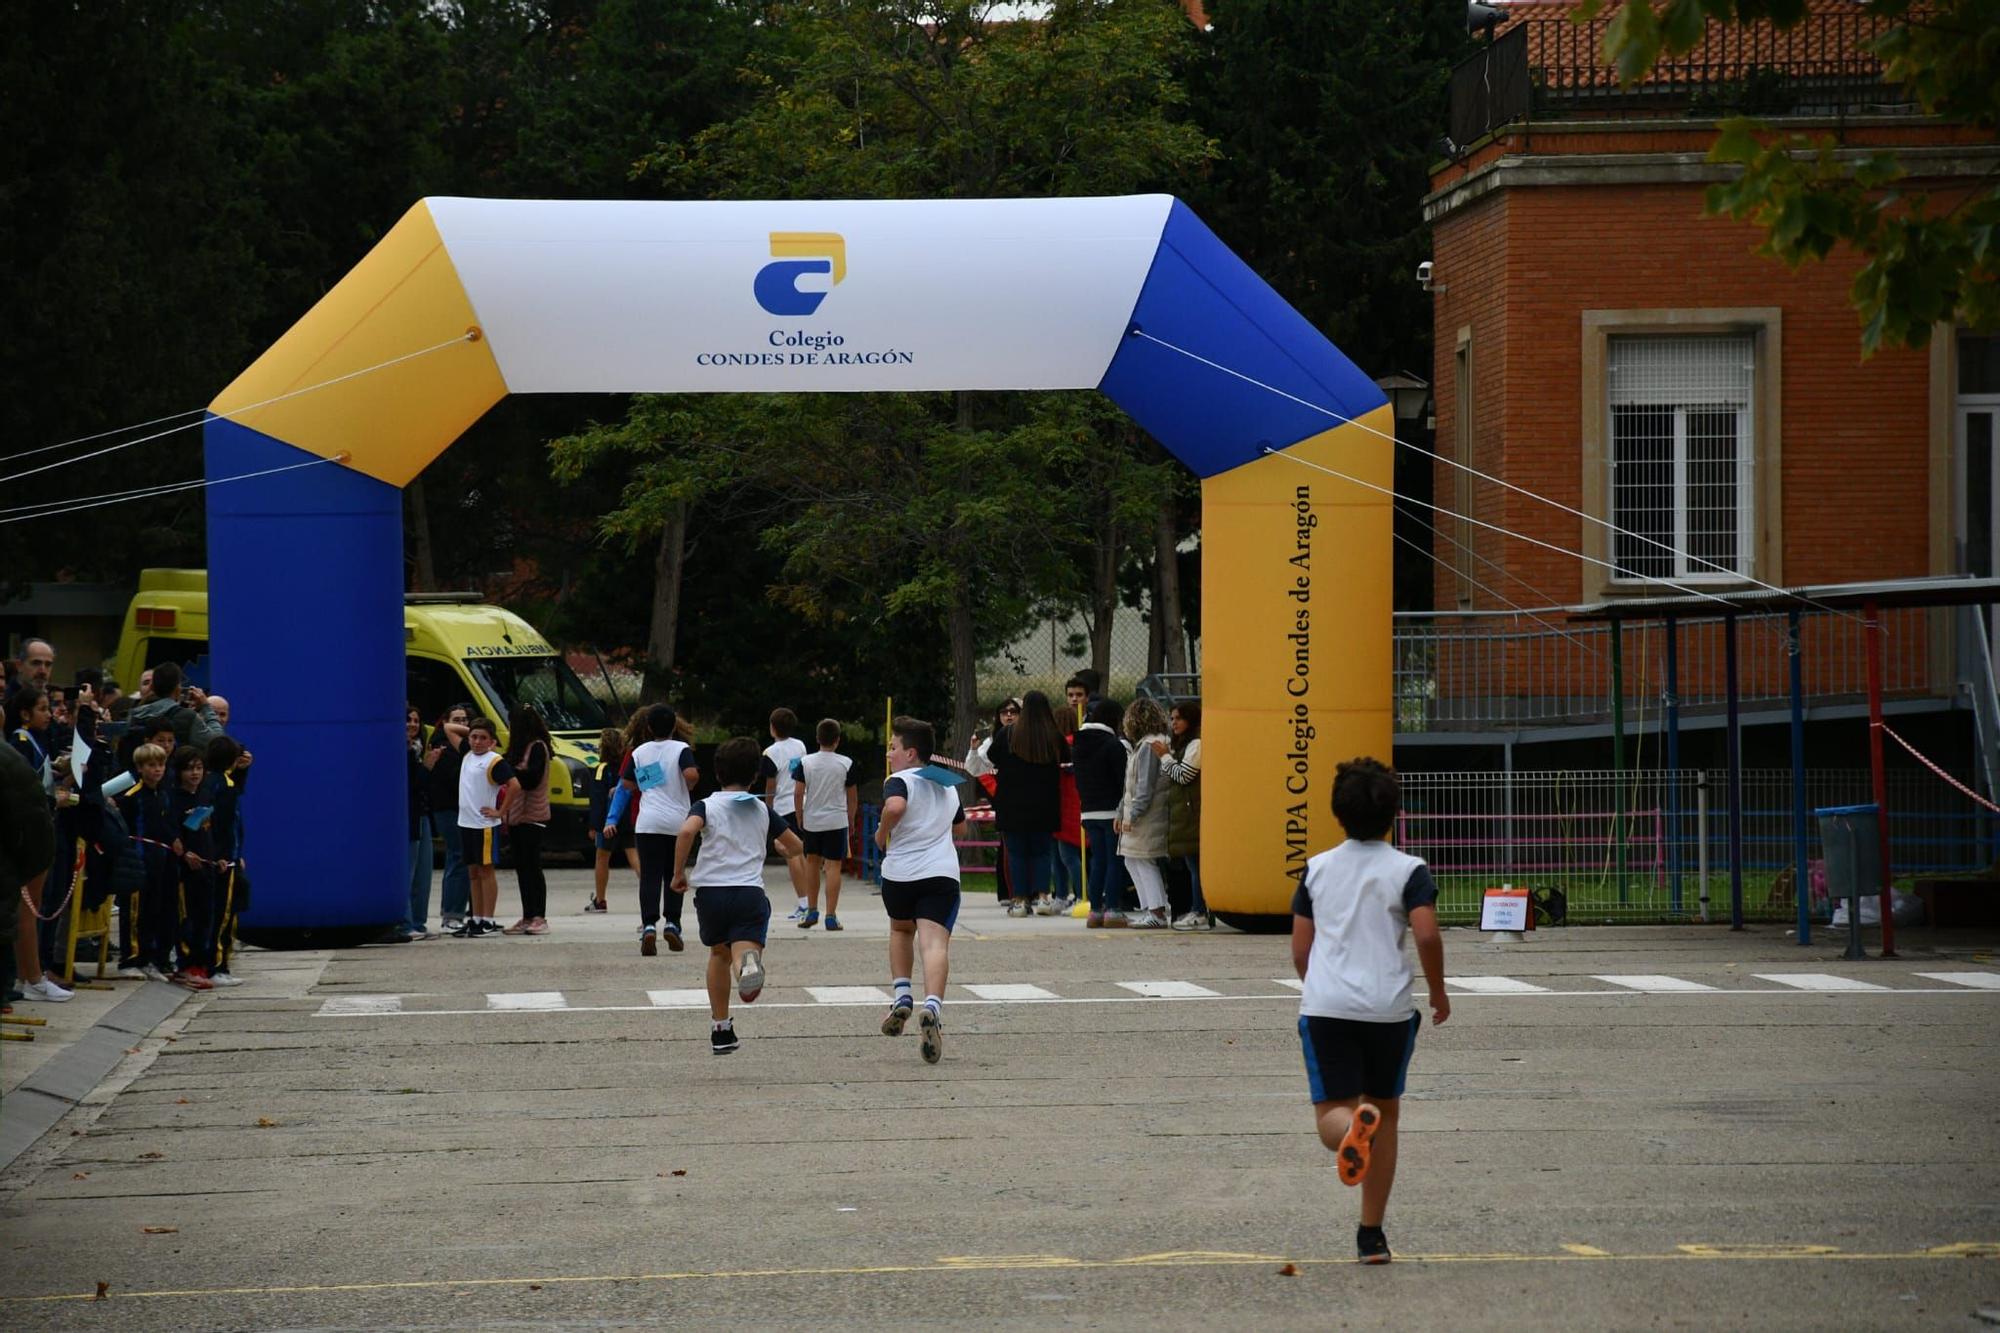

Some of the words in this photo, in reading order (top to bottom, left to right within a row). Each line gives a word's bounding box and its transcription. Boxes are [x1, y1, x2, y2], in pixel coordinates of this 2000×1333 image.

[696, 352, 785, 366] CONDES
[790, 352, 819, 365] DE
[822, 348, 914, 365] ARAGÓN
[768, 329, 845, 351] Colegio
[1288, 485, 1319, 571] Aragón
[1288, 576, 1310, 603] de
[1286, 609, 1310, 698] Condes
[1286, 704, 1317, 795] Colegio
[1286, 801, 1308, 882] AMPA
